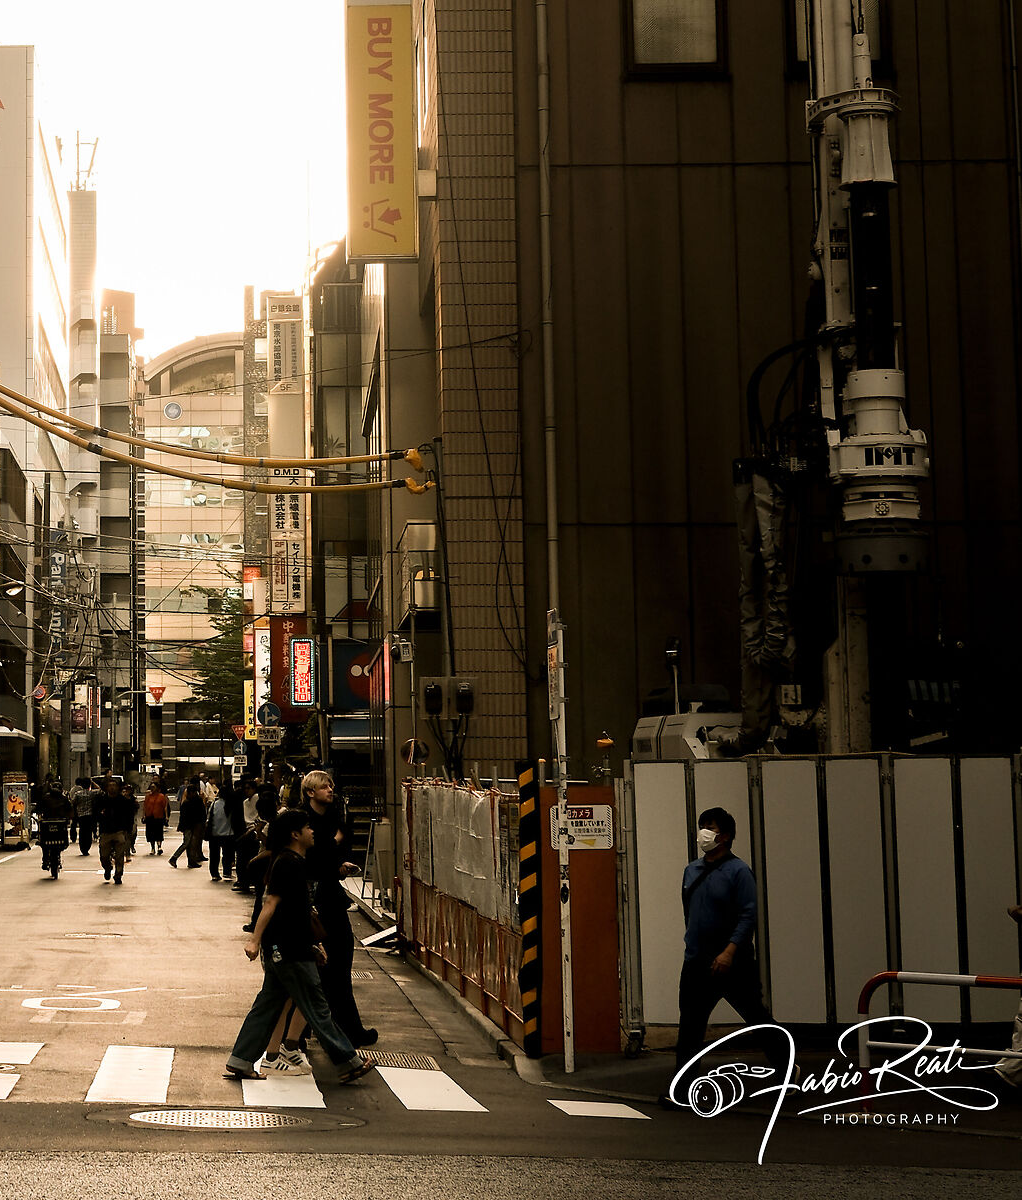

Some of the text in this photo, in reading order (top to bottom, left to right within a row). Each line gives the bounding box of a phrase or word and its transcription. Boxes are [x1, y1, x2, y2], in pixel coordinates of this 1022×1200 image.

[367, 17, 394, 184] BUY MORE
[865, 447, 915, 466] IMT
[282, 603, 295, 611] 2F
